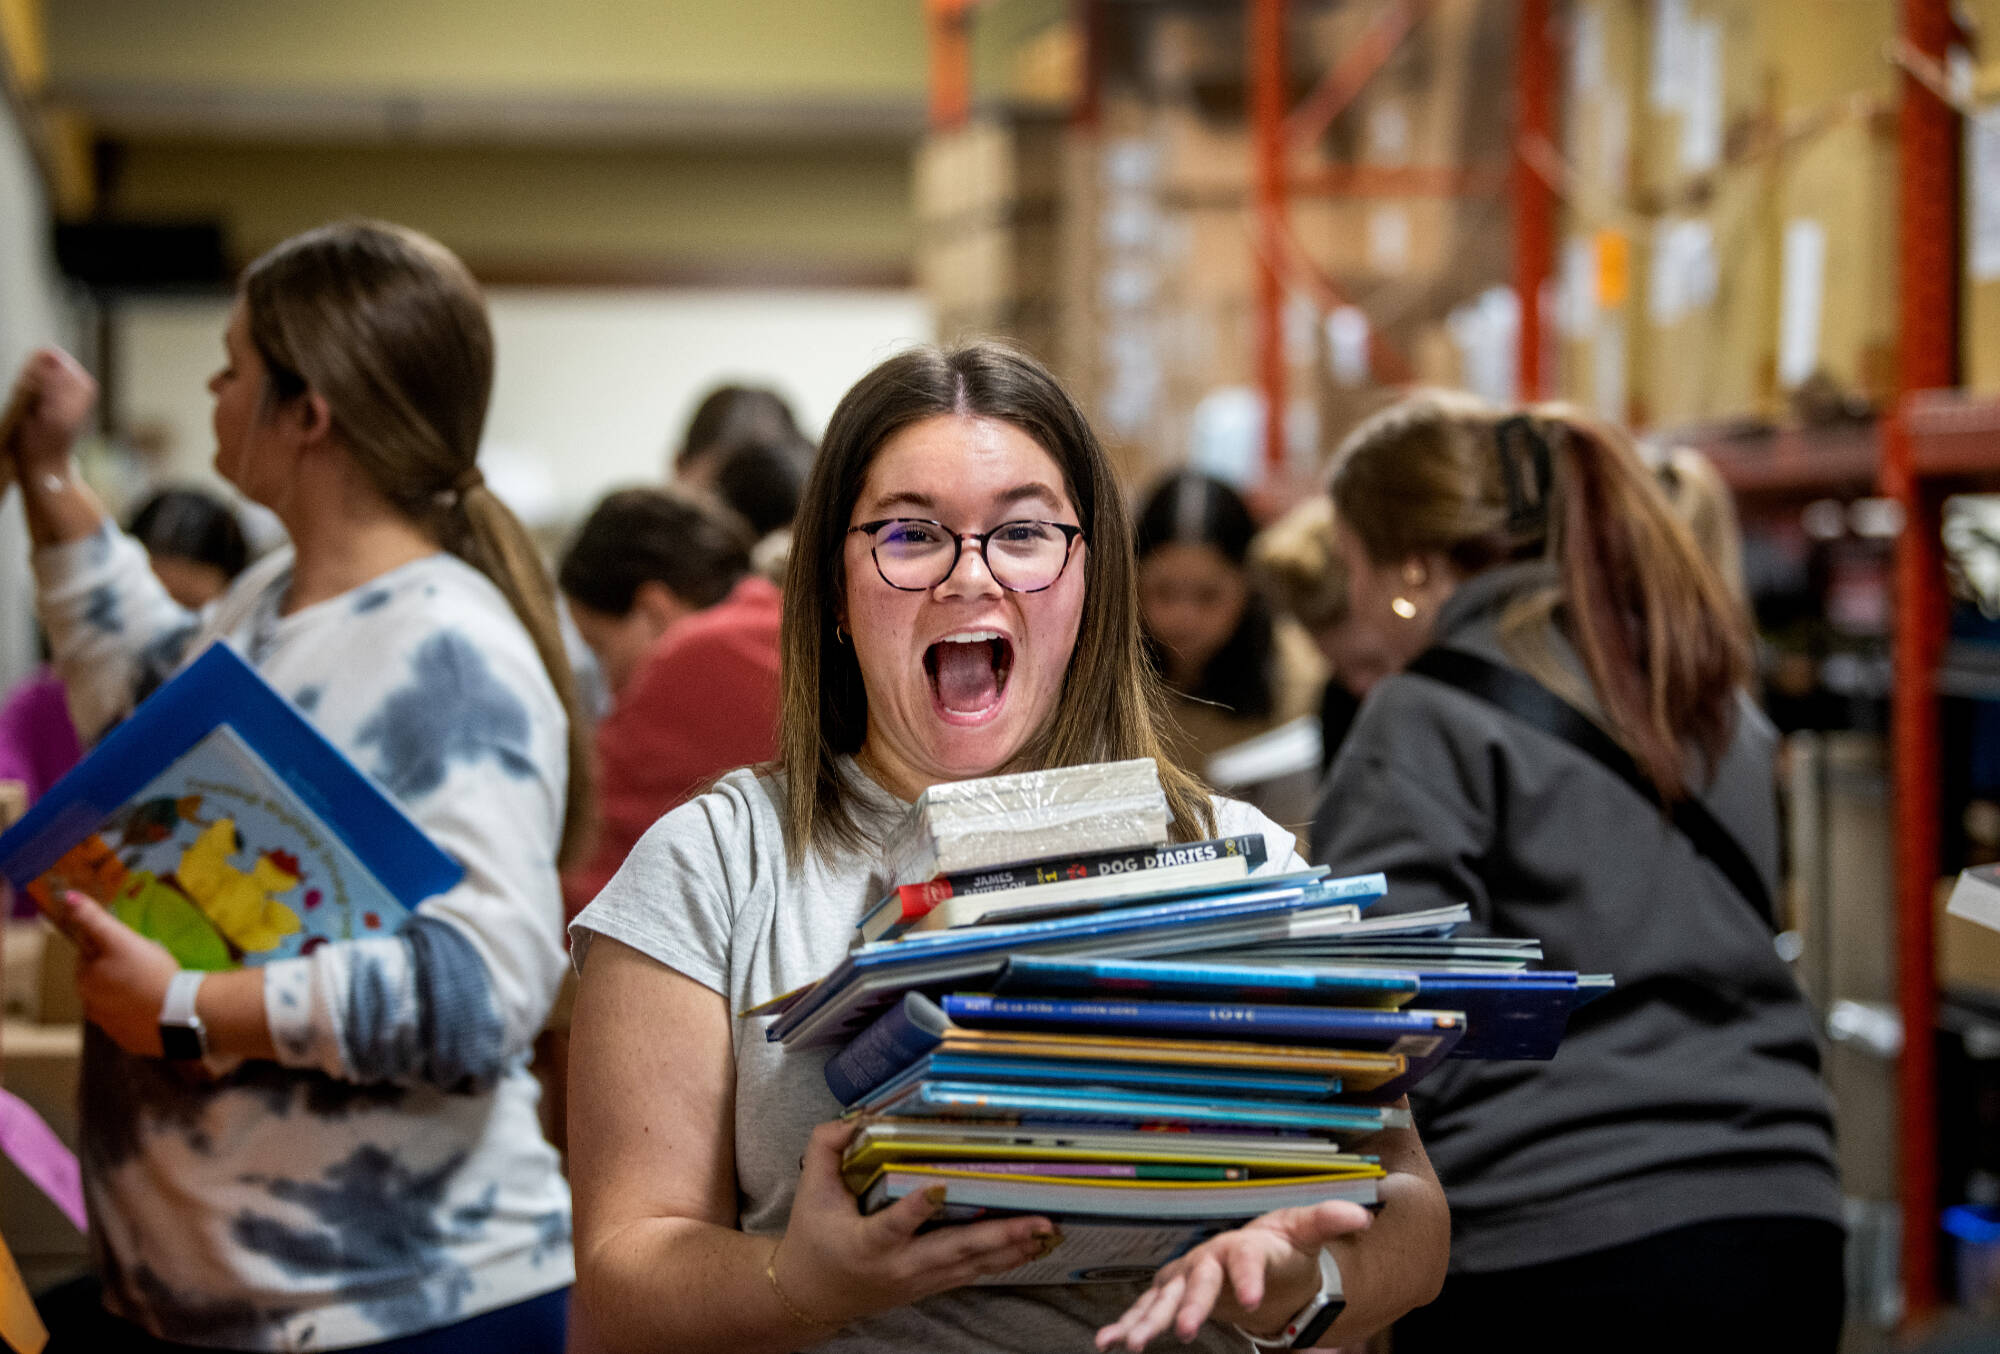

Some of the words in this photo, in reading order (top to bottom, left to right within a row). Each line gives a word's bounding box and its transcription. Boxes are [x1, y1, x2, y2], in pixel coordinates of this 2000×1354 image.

[1098, 858, 1138, 876] DOG
[1144, 845, 1218, 869] DIARIES
[973, 872, 1014, 887] JAMES
